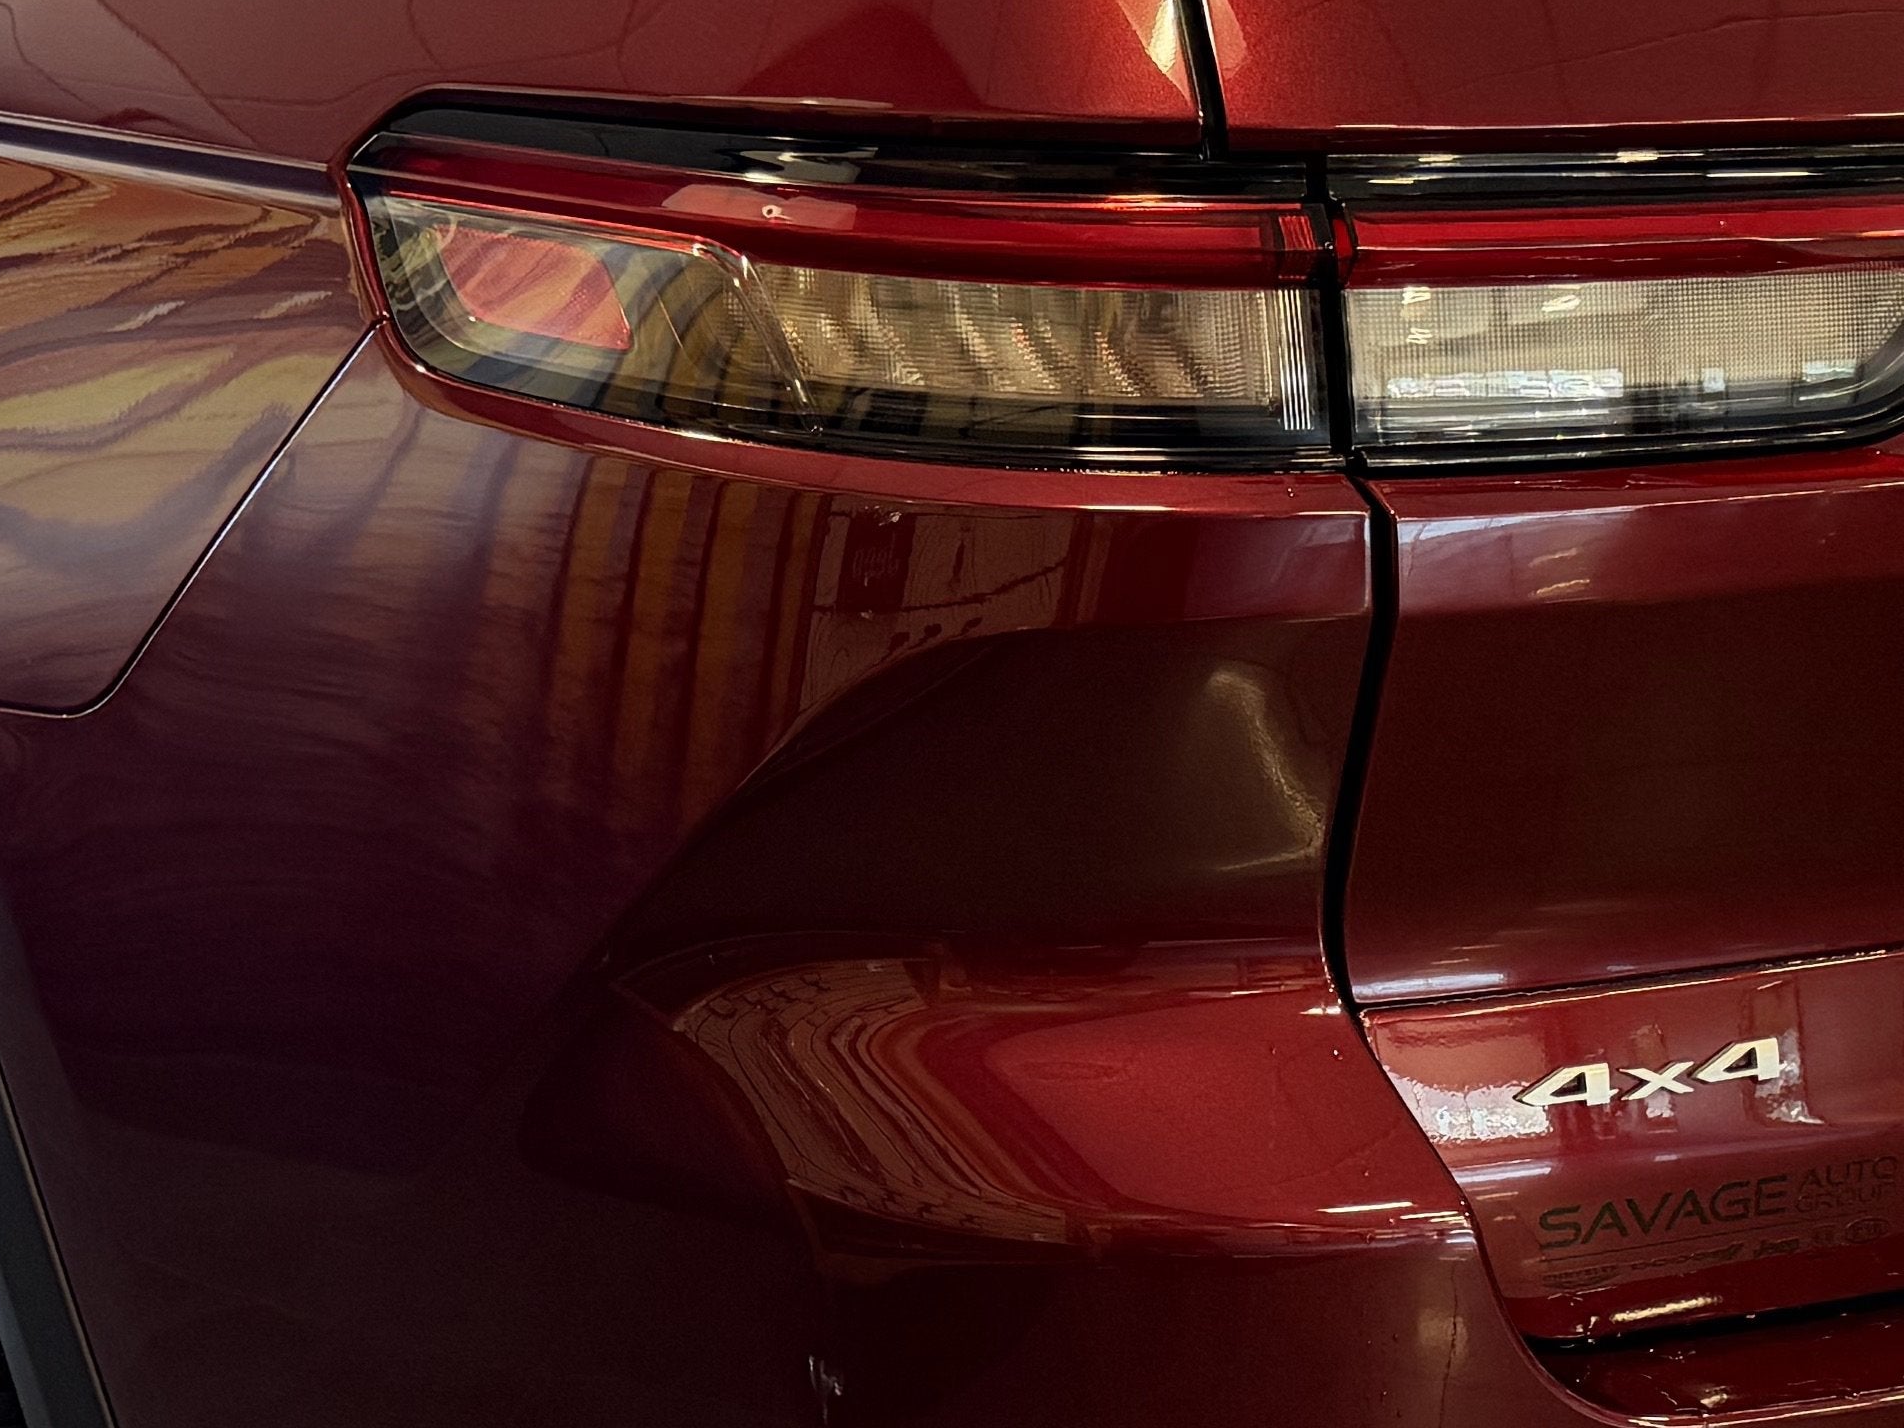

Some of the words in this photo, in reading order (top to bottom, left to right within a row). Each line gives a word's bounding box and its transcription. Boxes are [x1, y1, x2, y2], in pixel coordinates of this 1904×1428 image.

[1512, 1036, 1781, 1108] 4x4
[1539, 1174, 1788, 1251] SAVAGE
[1798, 1156, 1900, 1192] AUTO
